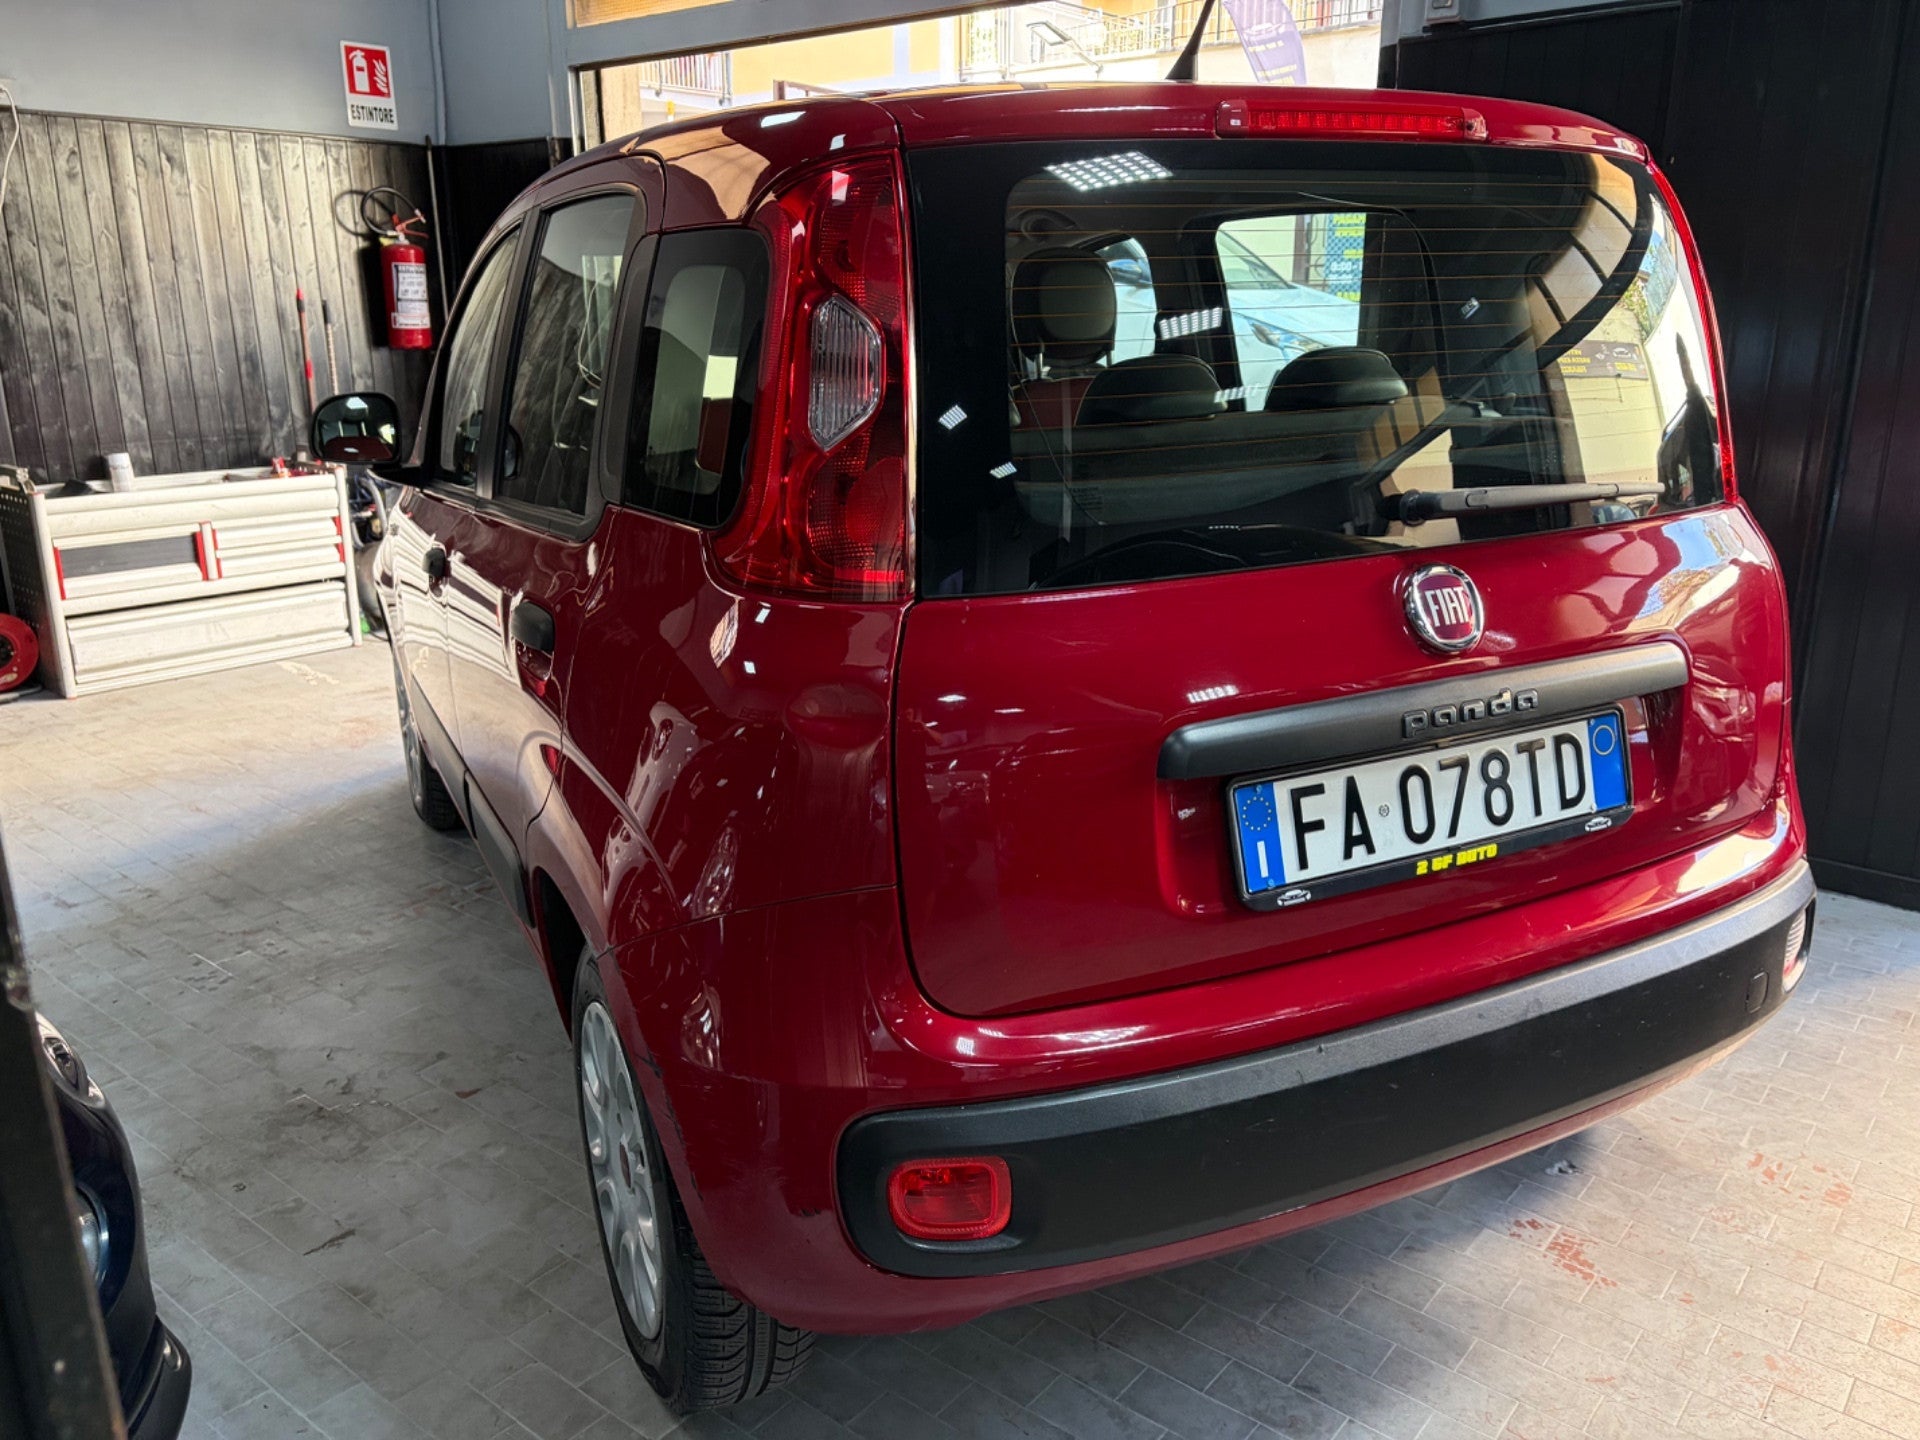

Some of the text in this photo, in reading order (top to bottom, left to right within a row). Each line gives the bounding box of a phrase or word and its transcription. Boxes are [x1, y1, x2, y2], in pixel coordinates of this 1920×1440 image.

[350, 104, 394, 123] ESTINTORE
[1424, 586, 1469, 627] FIAT
[1402, 687, 1539, 738] panda
[1290, 732, 1586, 871] FA 078TD
[1257, 840, 1269, 878] I
[1456, 843, 1498, 866] AUTO
